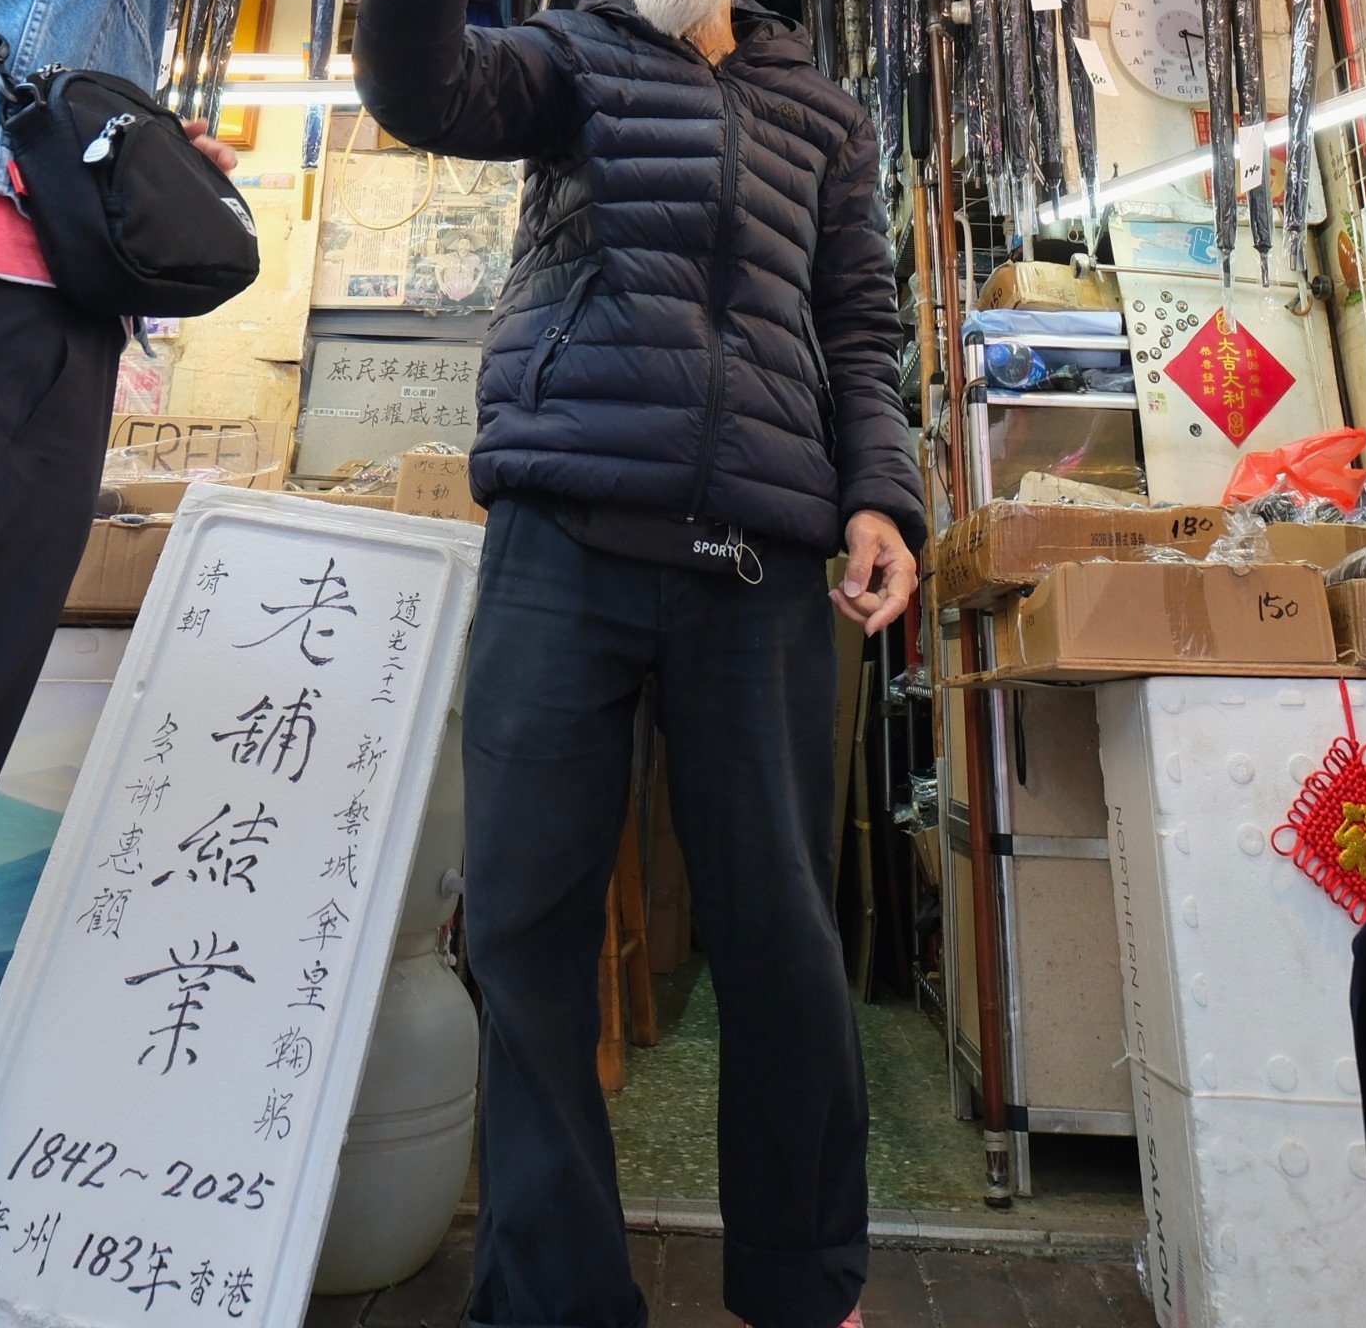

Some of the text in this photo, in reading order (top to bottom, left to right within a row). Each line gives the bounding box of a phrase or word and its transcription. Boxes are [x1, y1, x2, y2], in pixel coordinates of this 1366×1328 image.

[1244, 164, 1261, 179] 140
[402, 387, 437, 398] 衷心感謝
[1199, 346, 1216, 396] 恭喜發財
[1216, 337, 1245, 410] 大吉大利
[1171, 516, 1214, 539] 180
[176, 559, 229, 638] 清朝
[1258, 591, 1299, 622] 150
[124, 557, 357, 1076] 老舖結業
[1113, 805, 1174, 1309] NORTHERN LIGHTS SALMON
[71, 1233, 182, 1313] 183年
[190, 1259, 254, 1318] 香港
